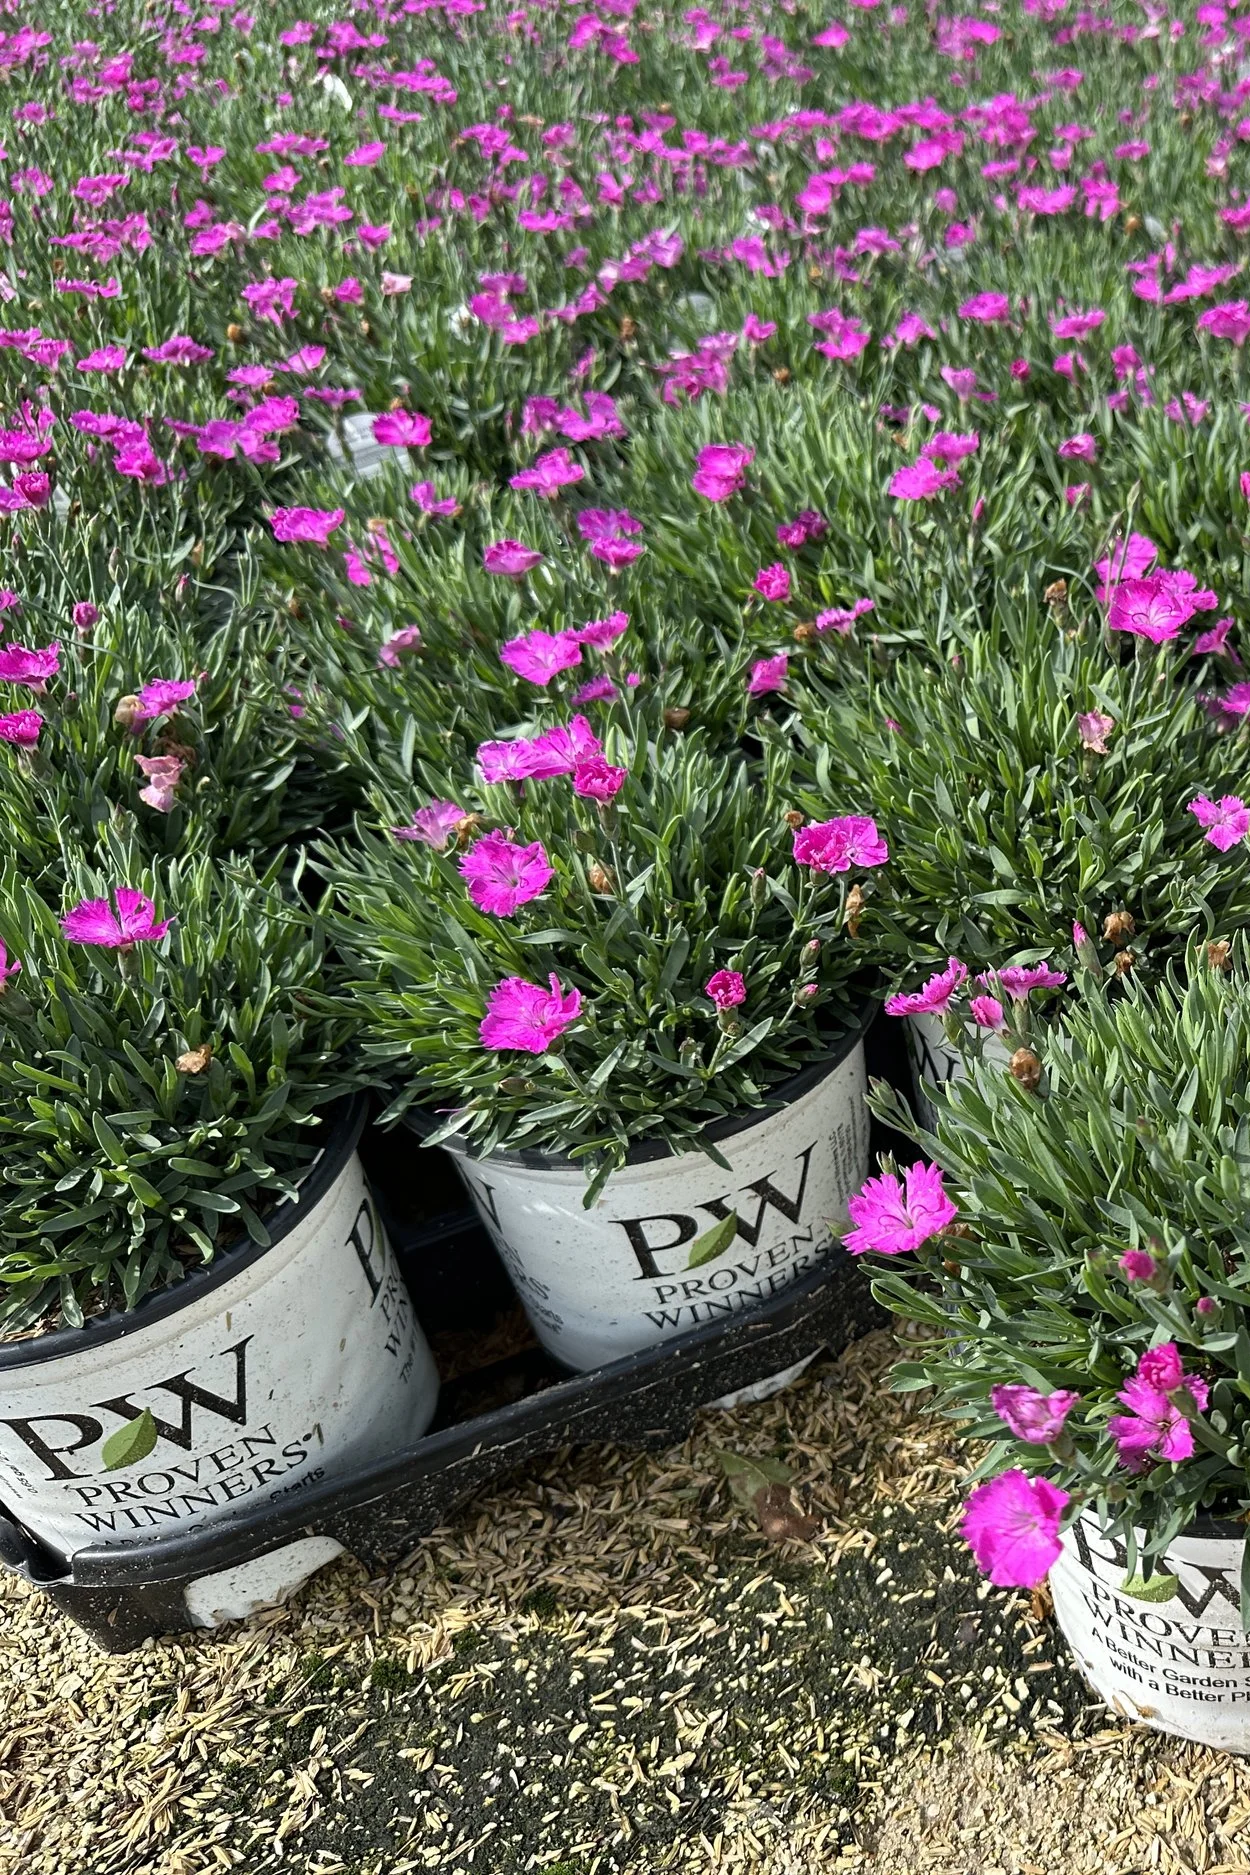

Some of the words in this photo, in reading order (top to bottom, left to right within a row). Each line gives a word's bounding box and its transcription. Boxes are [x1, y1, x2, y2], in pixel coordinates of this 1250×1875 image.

[608, 1140, 818, 1280] PW
[652, 1223, 814, 1305] PROVEN
[0, 1334, 255, 1481] PW
[72, 1422, 278, 1508] PROVEN
[1091, 1626, 1103, 1643] A
[1105, 1634, 1157, 1673] Better
[1162, 1668, 1238, 1689] Garden
[1109, 1655, 1143, 1684] with
[1148, 1678, 1160, 1691] a
[1165, 1682, 1226, 1704] Better
